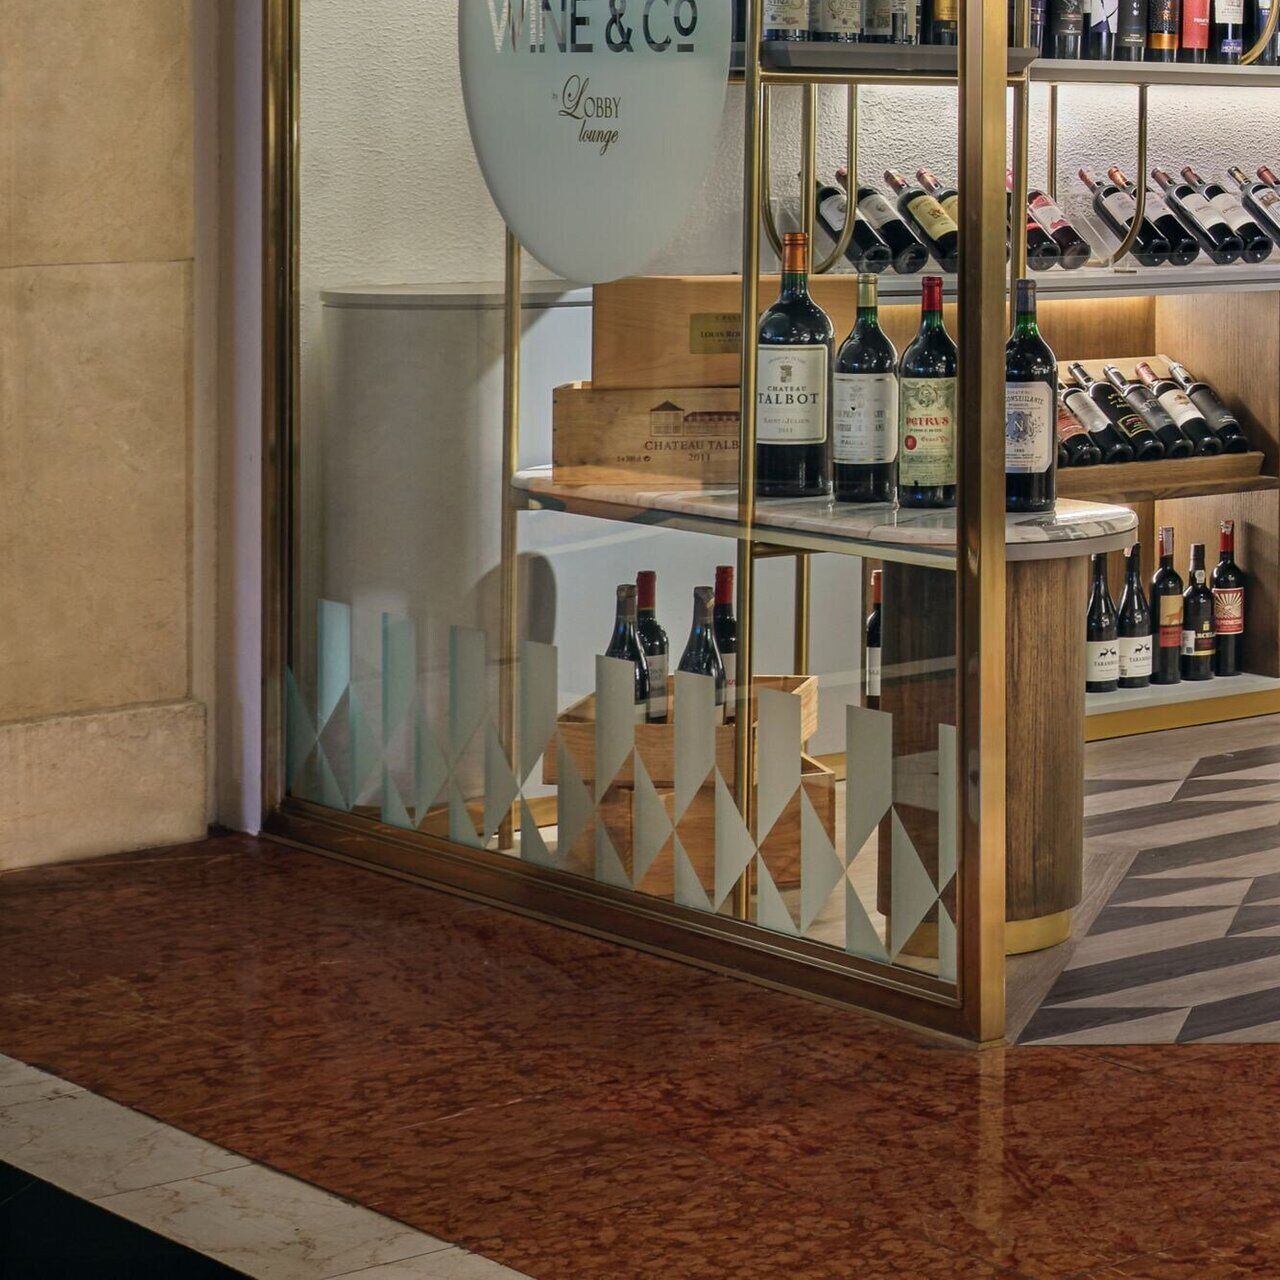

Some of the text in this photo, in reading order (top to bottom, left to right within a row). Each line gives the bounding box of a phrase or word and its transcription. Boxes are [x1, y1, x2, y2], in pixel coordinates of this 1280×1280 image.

[578, 119, 619, 156] lounge
[758, 392, 820, 405] TALBOT
[905, 416, 950, 426] PETRUS
[644, 440, 704, 451] CHATEAU
